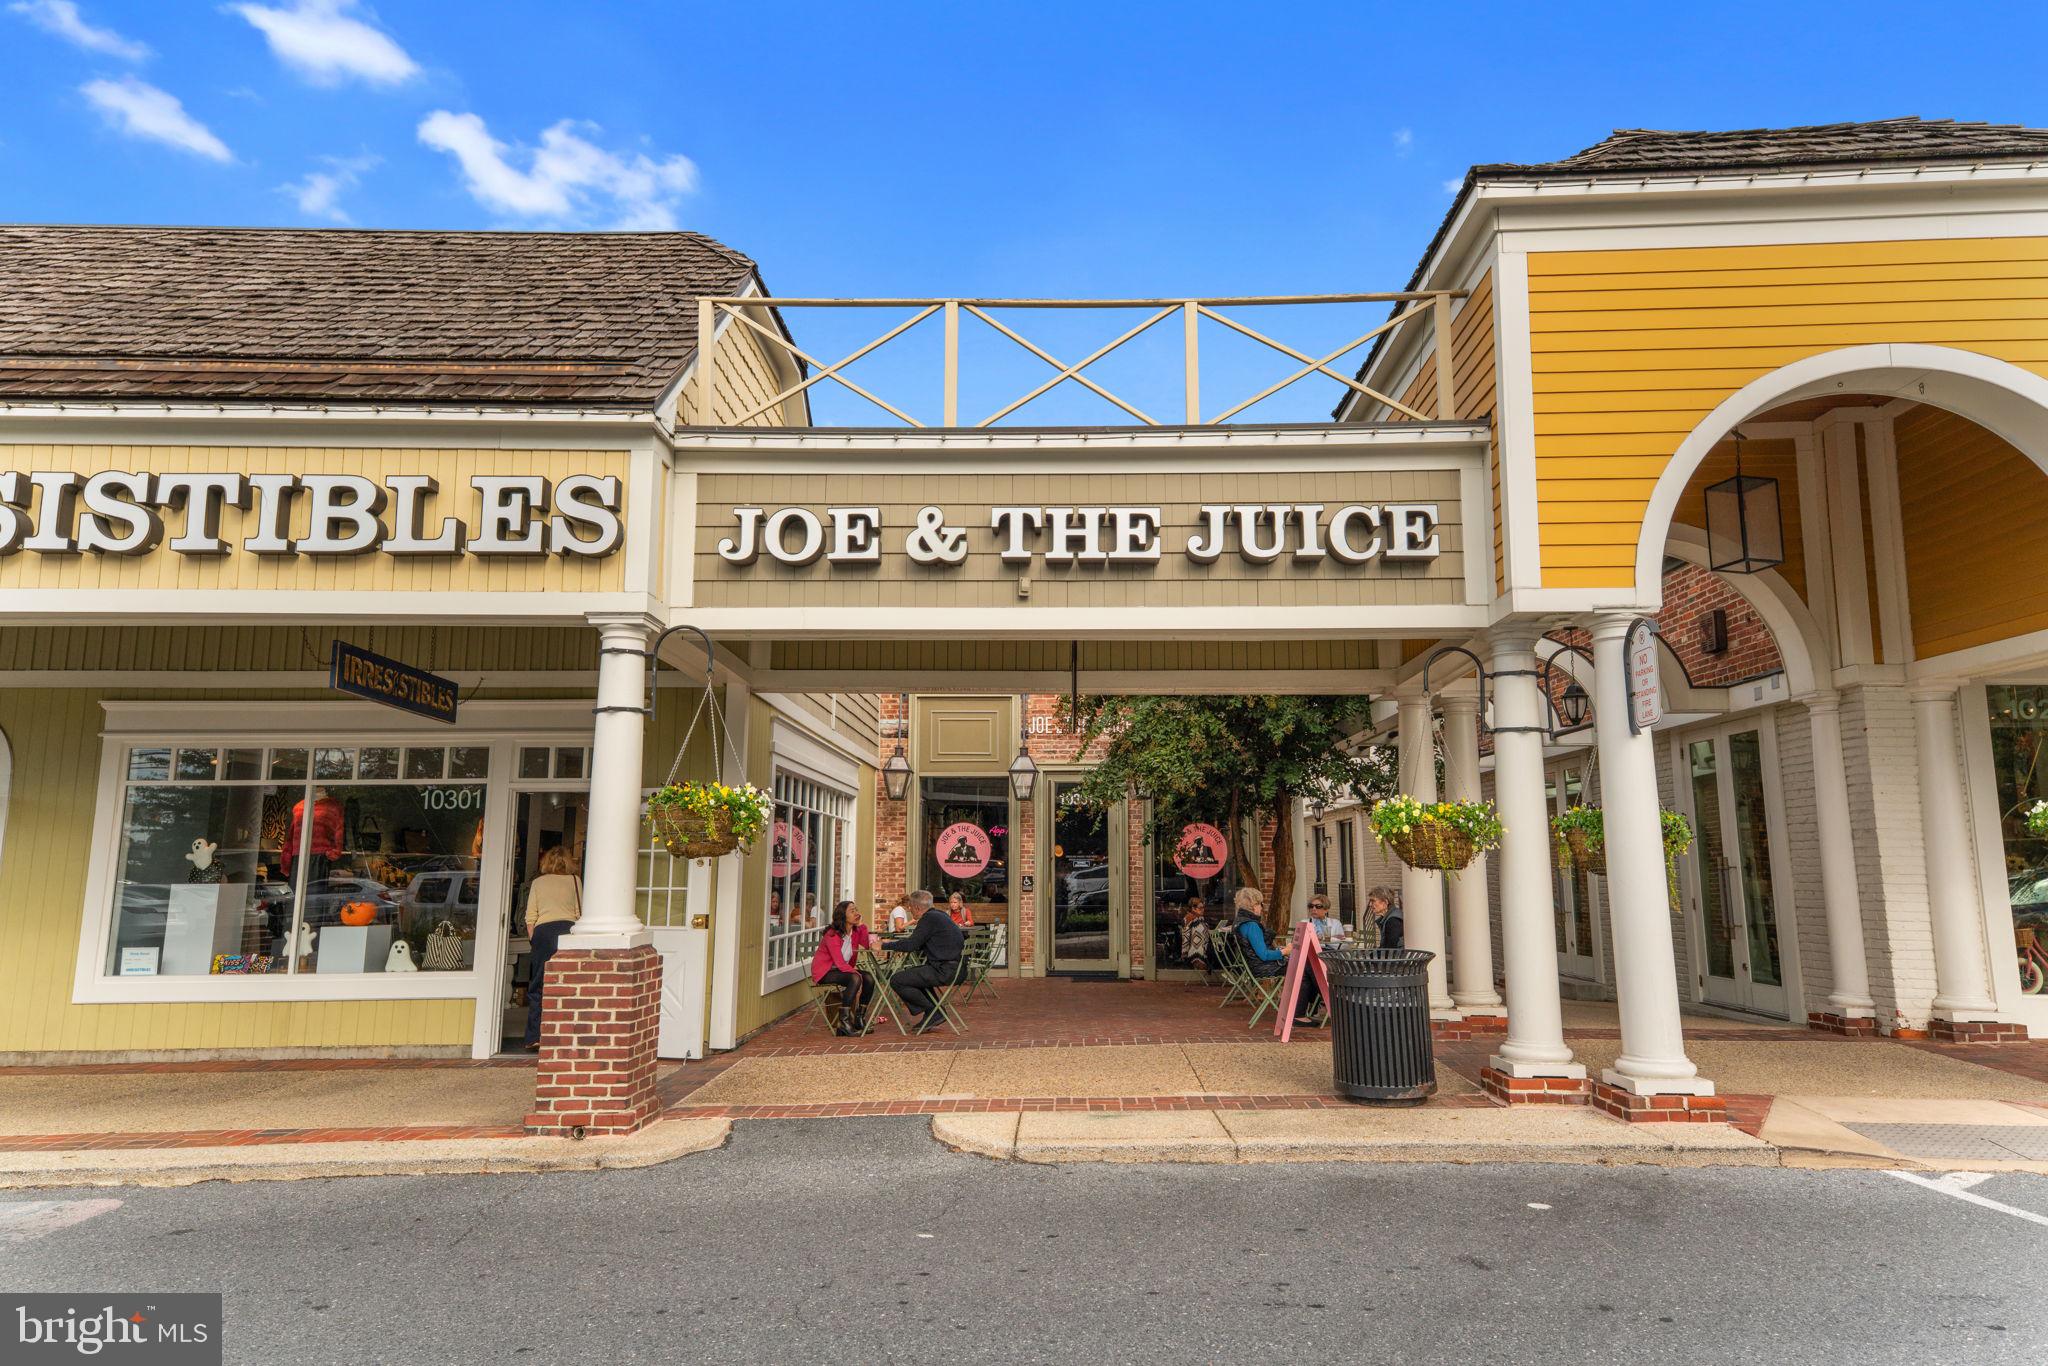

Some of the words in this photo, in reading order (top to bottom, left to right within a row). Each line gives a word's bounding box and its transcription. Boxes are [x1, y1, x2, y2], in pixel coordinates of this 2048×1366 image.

[0, 470, 623, 556] ISTIBLES
[717, 507, 881, 564] JOE
[905, 505, 968, 563] &
[991, 507, 1161, 562] THE
[1187, 504, 1439, 562] JUICE
[1639, 653, 1648, 665] NO
[1635, 665, 1654, 677] PARKING
[1635, 686, 1657, 699] STANDING
[1642, 709, 1653, 718] LANE
[1028, 716, 1054, 734] JOE
[420, 789, 481, 810] 10301
[941, 831, 951, 845] JOE
[957, 825, 970, 833] THE
[970, 829, 987, 846] JUICE
